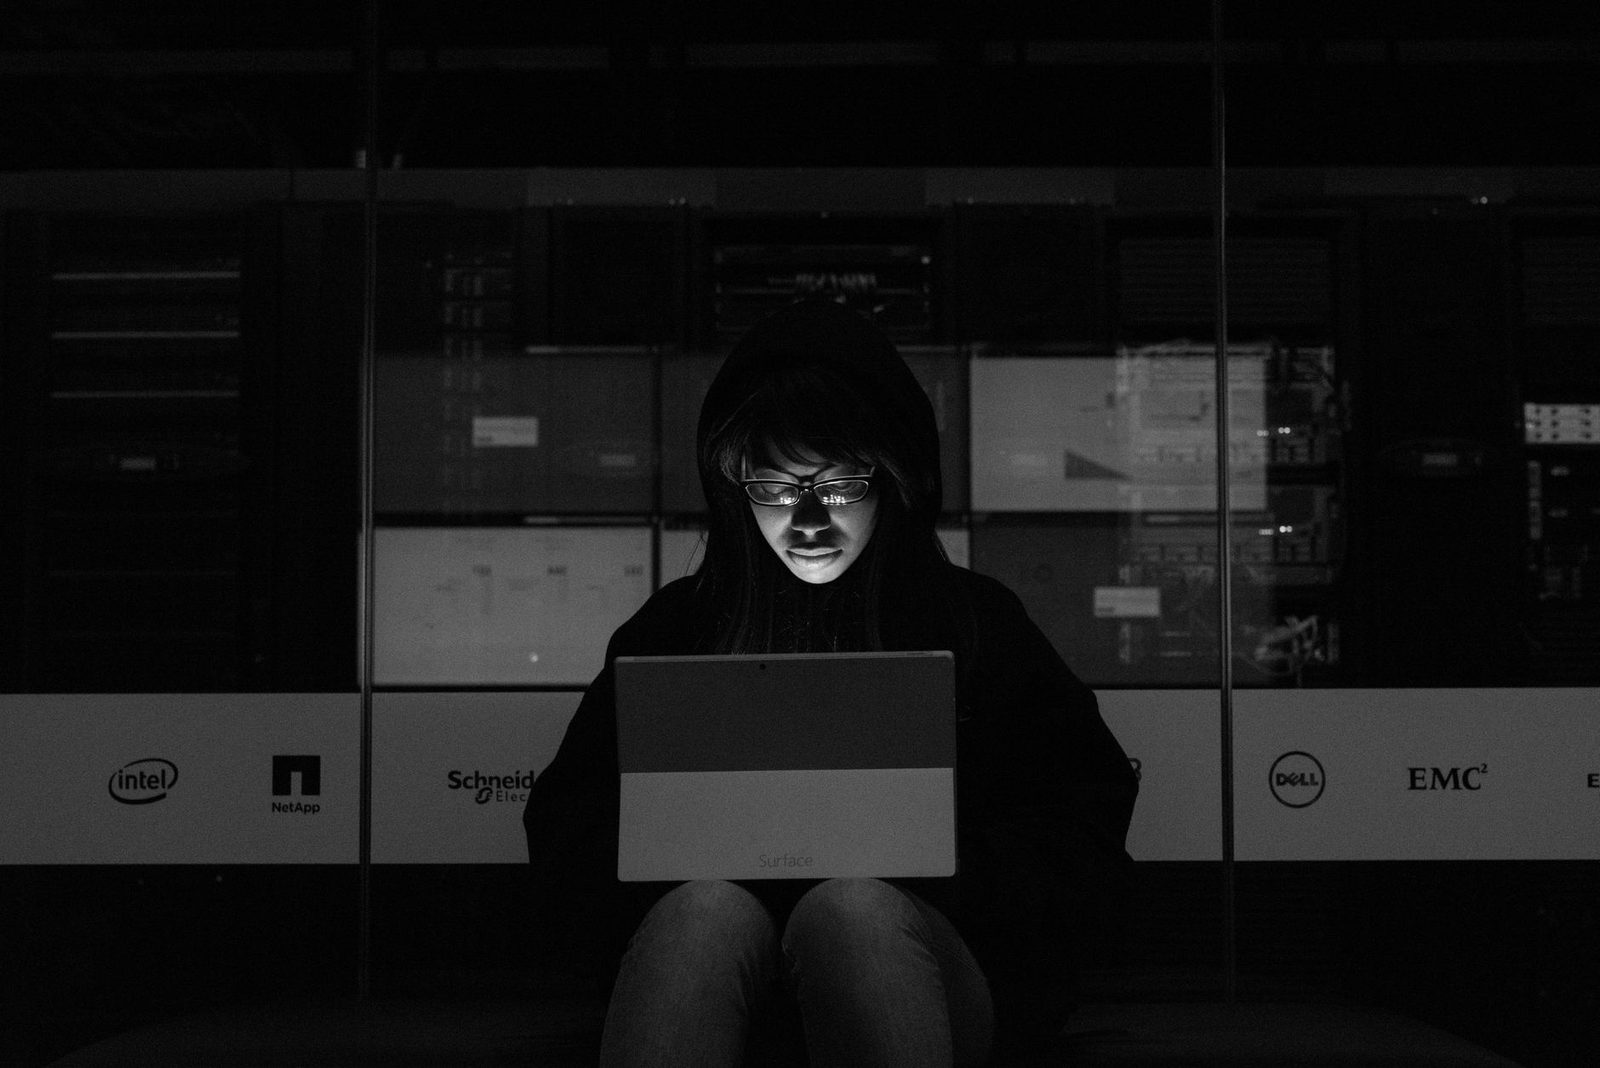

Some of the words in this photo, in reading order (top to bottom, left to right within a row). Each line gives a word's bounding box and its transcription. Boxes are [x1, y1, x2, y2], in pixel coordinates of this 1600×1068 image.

[117, 769, 167, 790] intel
[1275, 772, 1320, 787] DELL
[270, 801, 321, 815] NetApp
[759, 854, 814, 868] Surface
